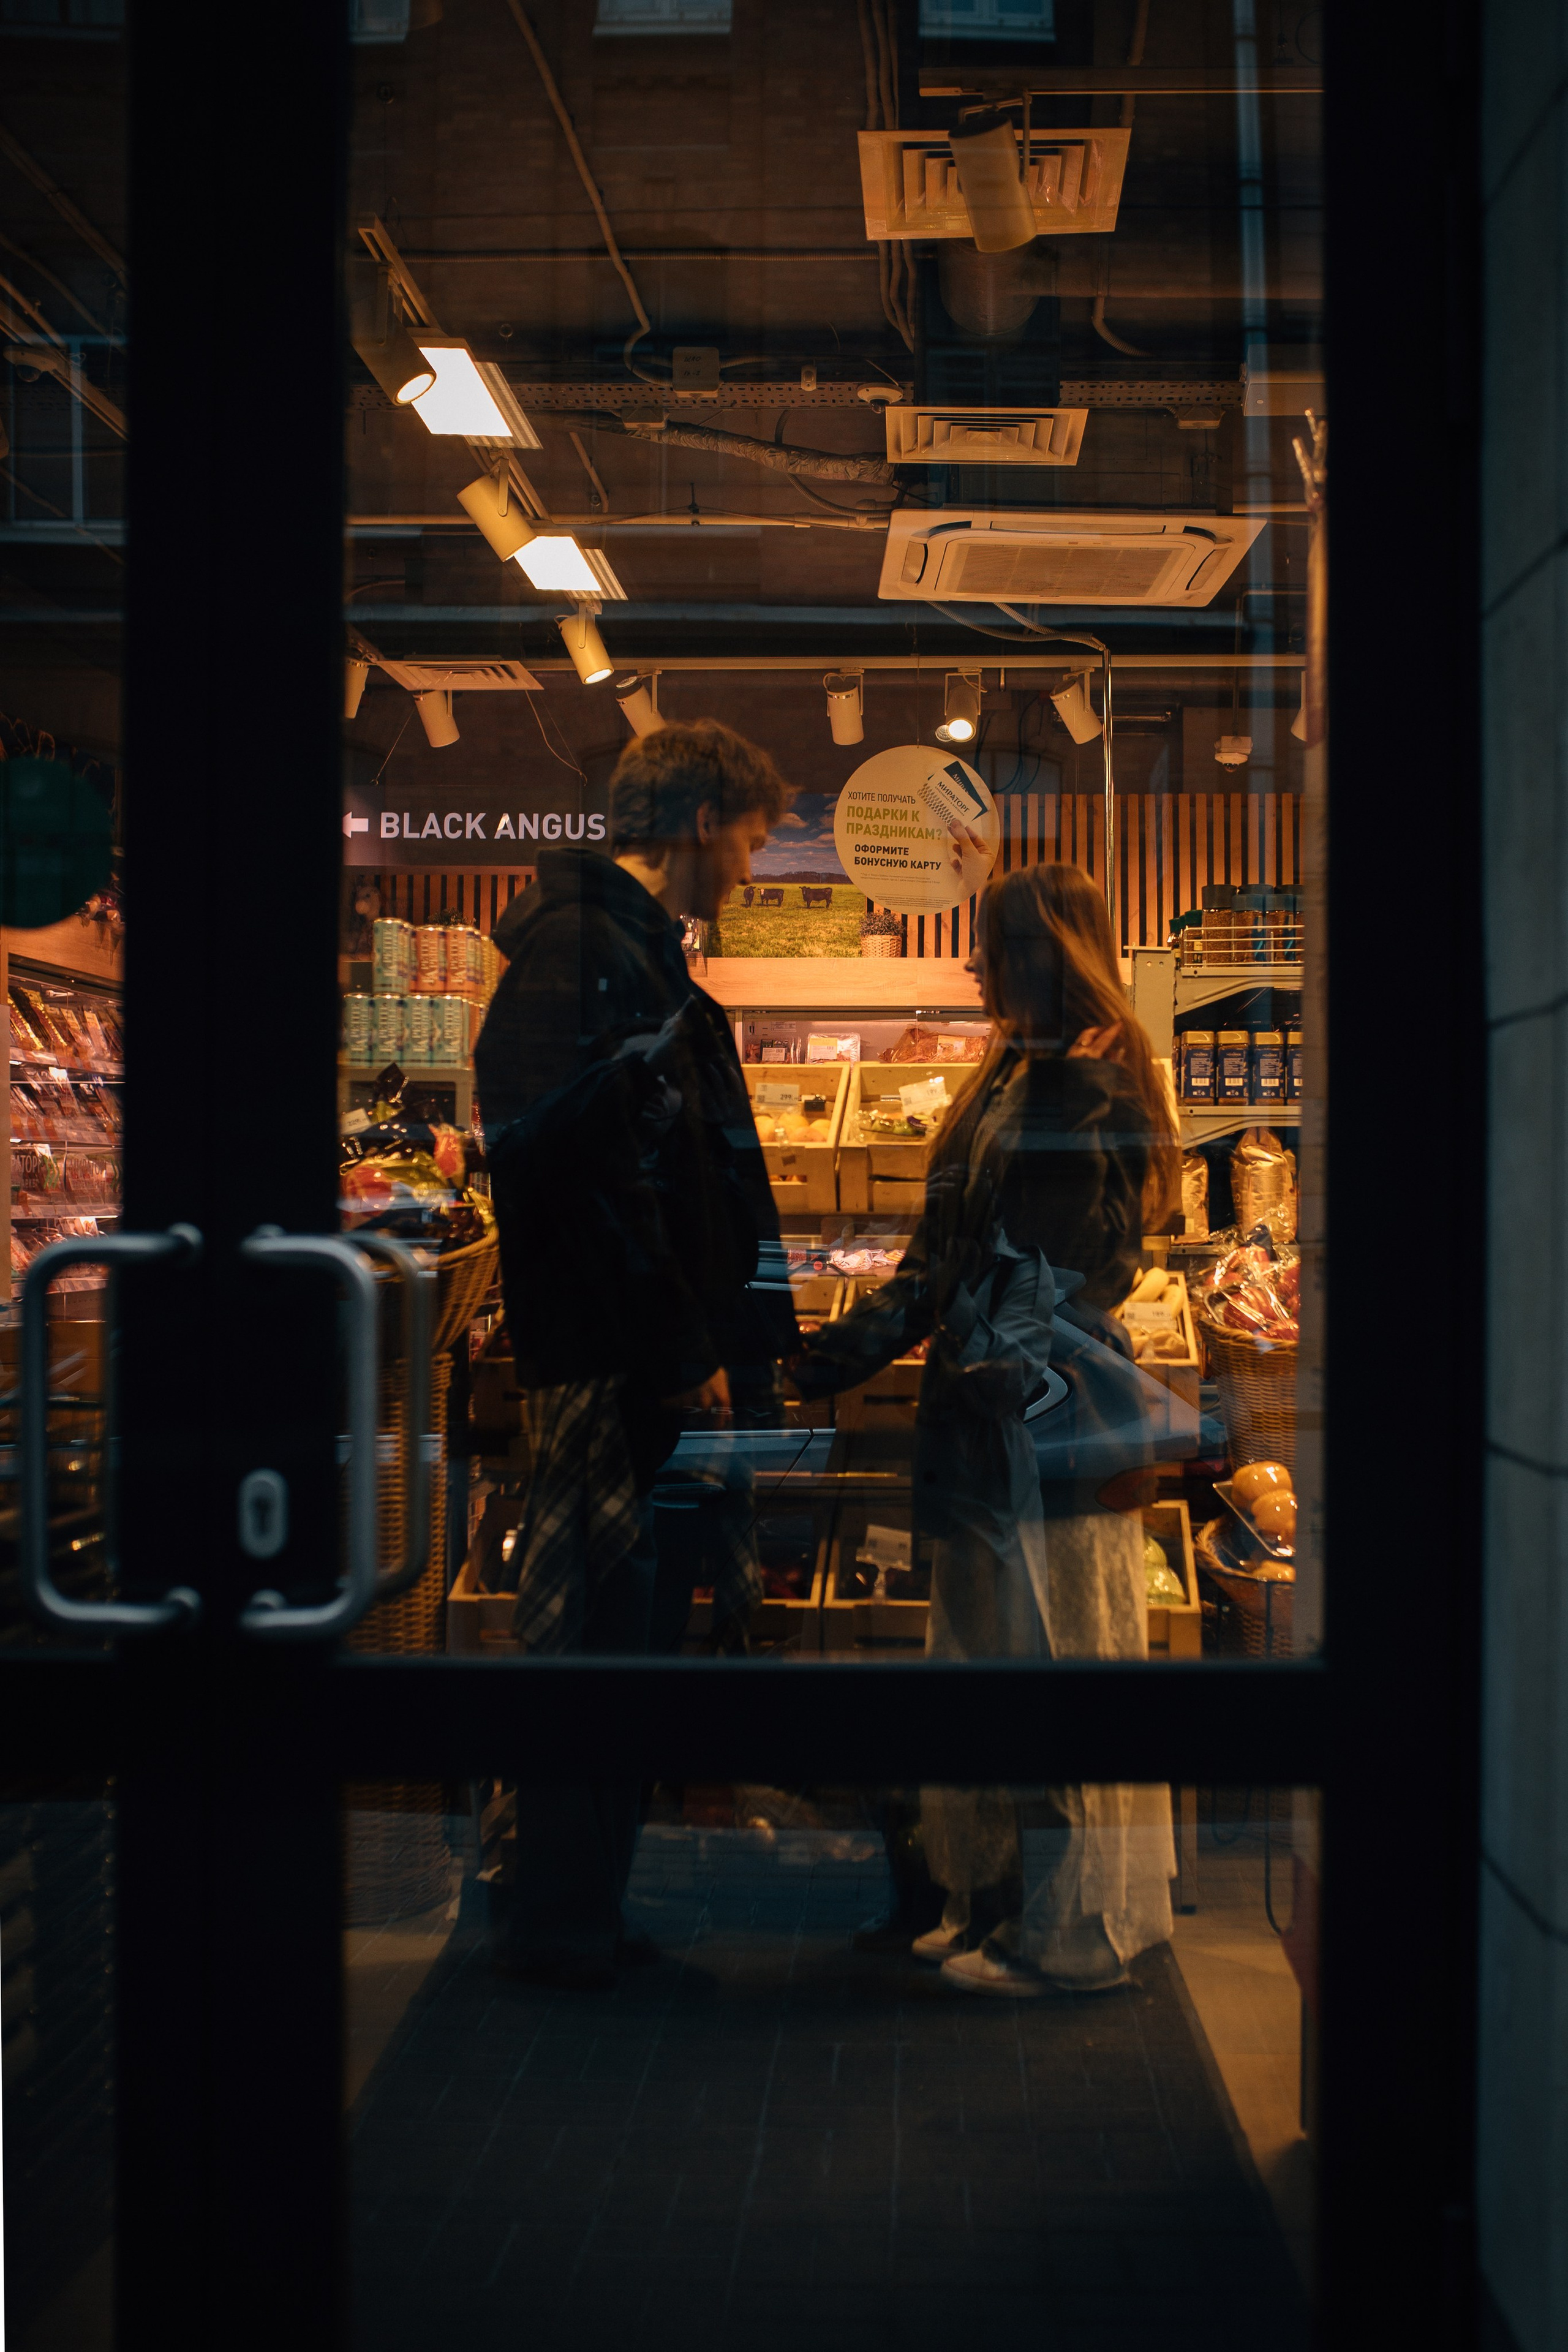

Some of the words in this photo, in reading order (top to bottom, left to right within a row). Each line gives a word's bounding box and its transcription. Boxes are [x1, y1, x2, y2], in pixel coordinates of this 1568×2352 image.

[848, 791, 875, 801] ХОТИТЕ
[877, 793, 916, 804] ПОЛУЧАТЬ
[937, 782, 970, 813] МИРАТОРГ
[846, 805, 908, 821] ПОДАРКИ
[911, 810, 920, 822] К
[380, 812, 487, 839] BLACK
[494, 813, 606, 841] ANGUS
[846, 823, 943, 840] ПРАЗДНИКАМ?
[854, 844, 909, 856] ОФОРМИТЕ
[854, 856, 908, 869] БОНУСНУЮ
[910, 860, 941, 870] КАРТУ
